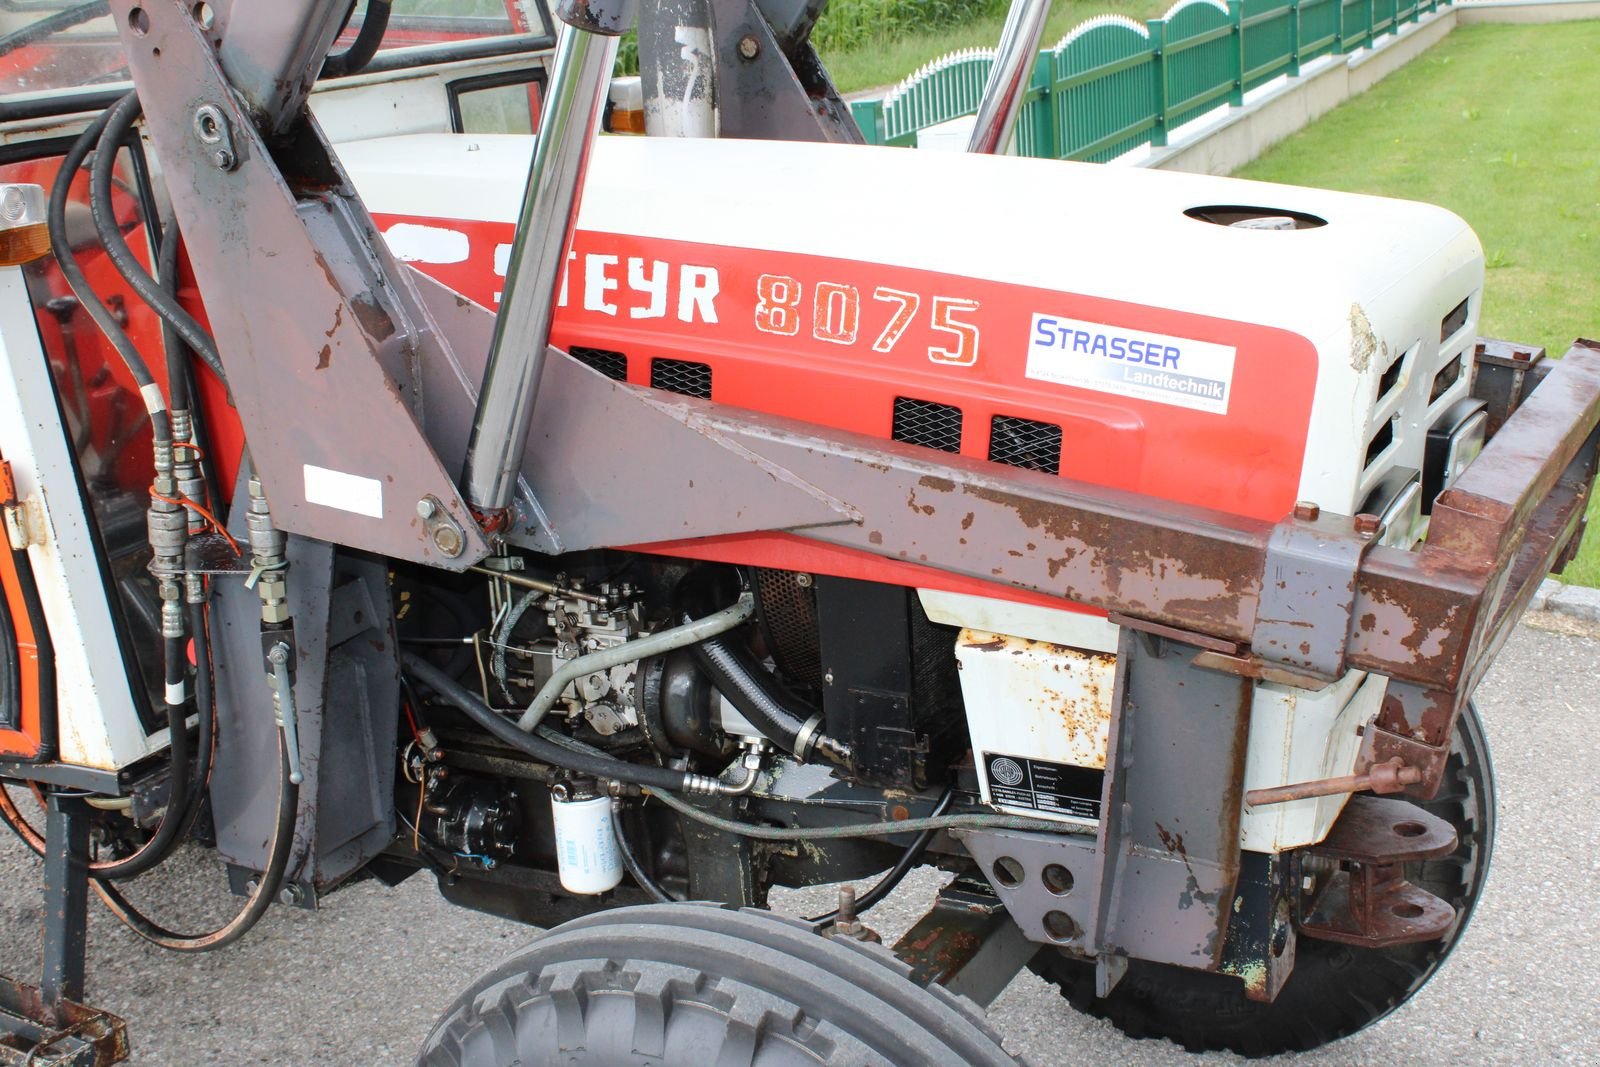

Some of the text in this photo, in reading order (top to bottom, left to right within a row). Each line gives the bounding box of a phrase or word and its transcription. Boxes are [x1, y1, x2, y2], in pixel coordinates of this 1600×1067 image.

[755, 273, 981, 367] 8075
[1035, 318, 1181, 370] STRASSER
[1123, 366, 1223, 399] Landtechnik
